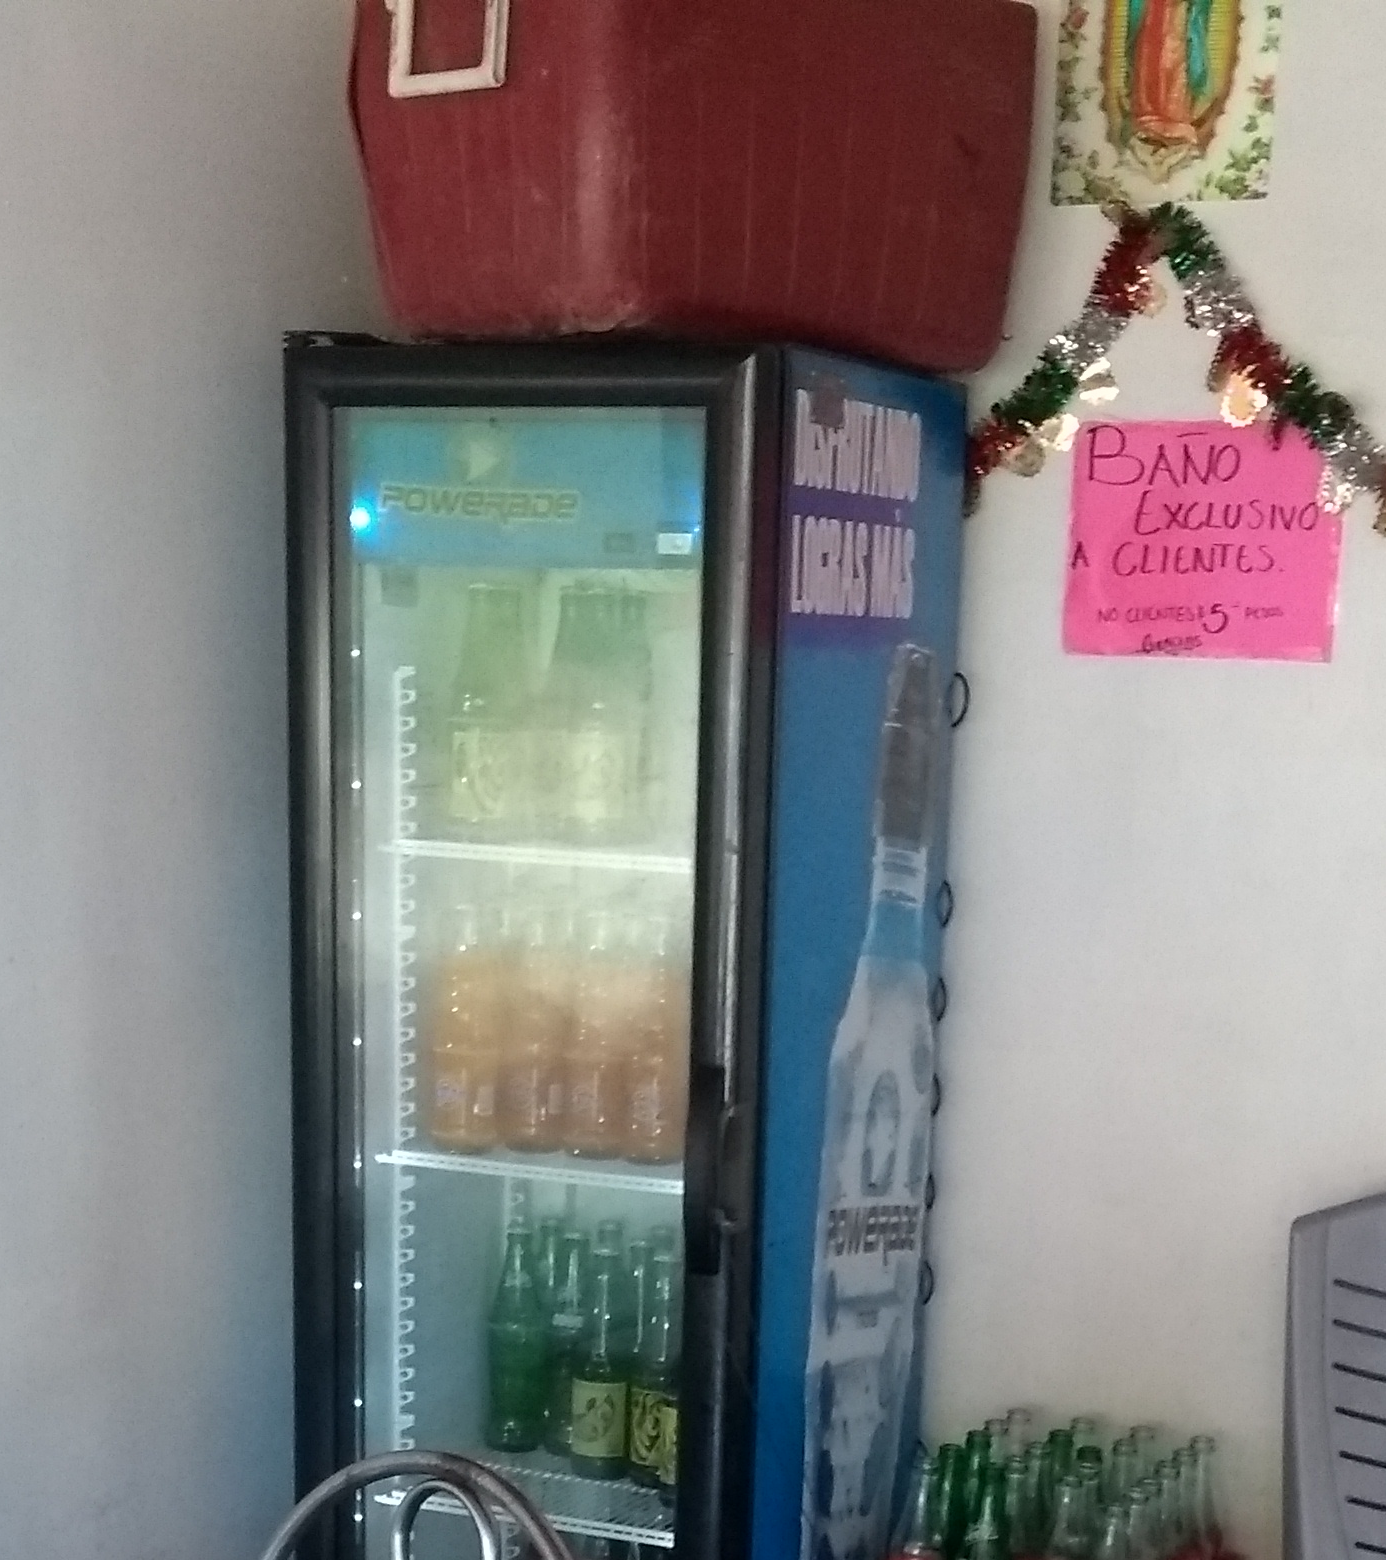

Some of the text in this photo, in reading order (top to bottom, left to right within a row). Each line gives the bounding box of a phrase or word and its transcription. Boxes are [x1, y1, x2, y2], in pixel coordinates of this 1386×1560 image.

[1086, 424, 1242, 488] BAÑO
[1133, 488, 1320, 536] EXCLUSIVO
[791, 514, 868, 617] LOGRAS
[1071, 541, 1090, 571] A
